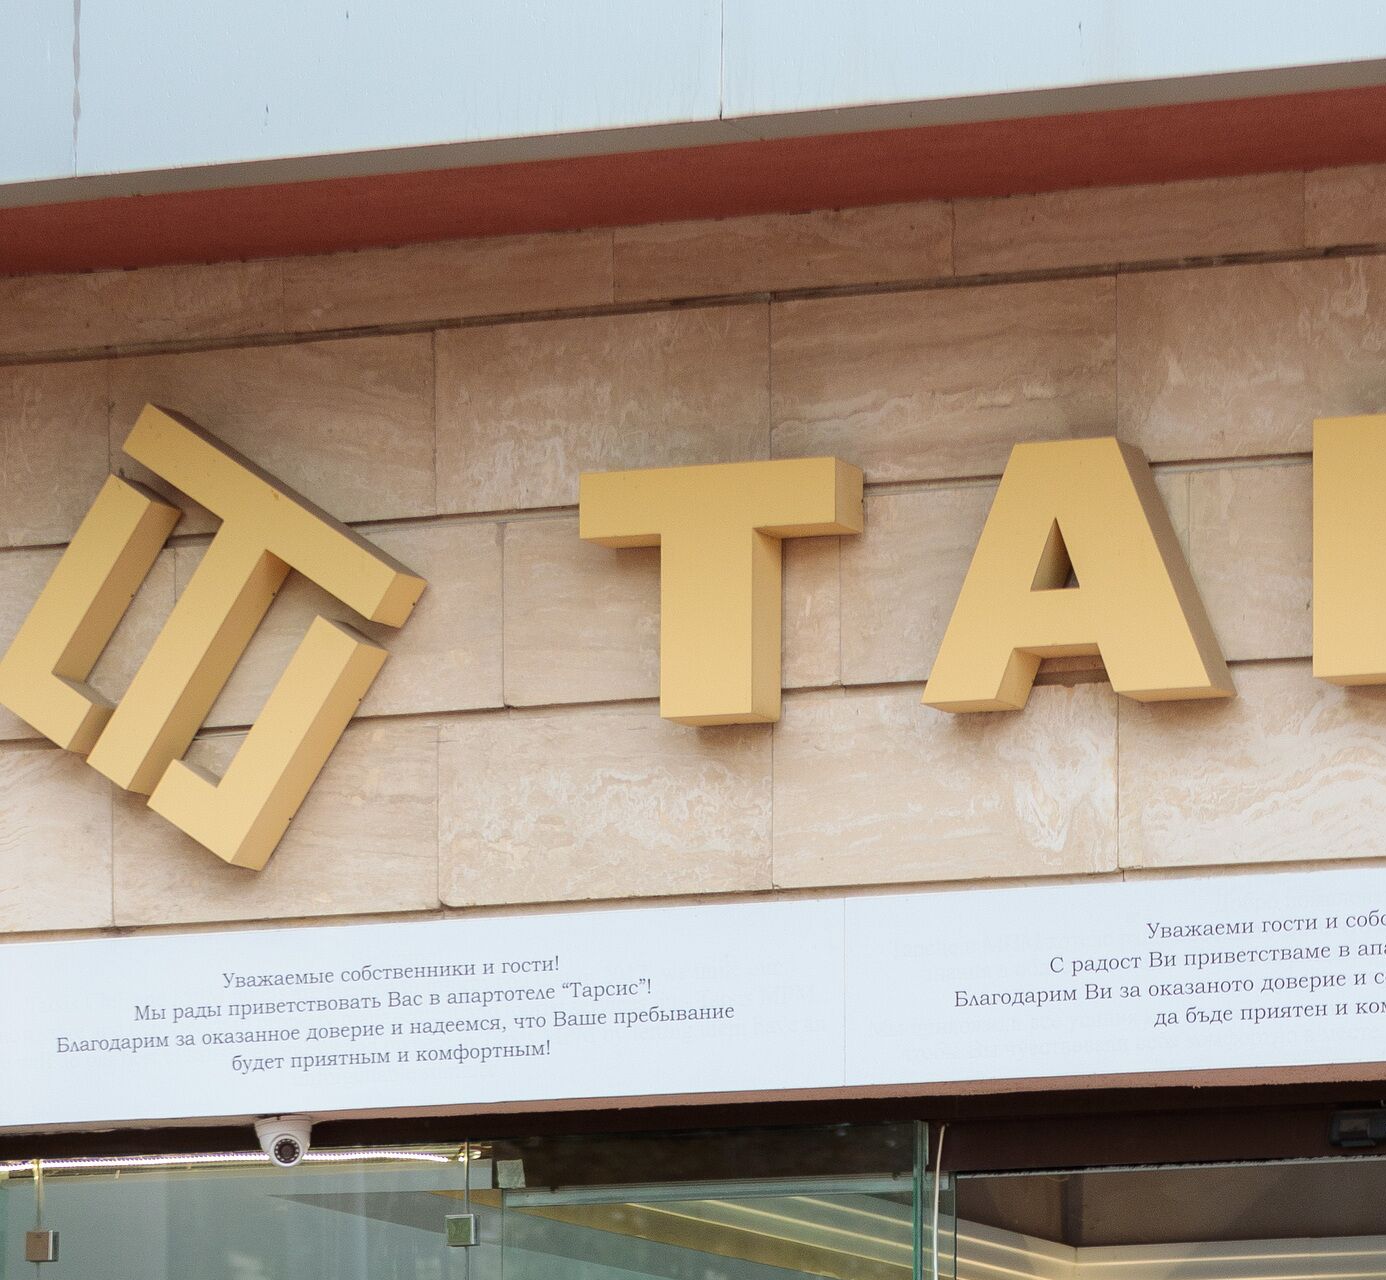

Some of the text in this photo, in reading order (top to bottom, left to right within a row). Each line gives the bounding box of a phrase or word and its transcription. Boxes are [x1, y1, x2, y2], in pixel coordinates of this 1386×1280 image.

[1145, 921, 1255, 940] Уважаеми
[1261, 917, 1318, 934] гости
[1325, 916, 1339, 930] и
[221, 954, 559, 989] Уважаемые собственники и гости!
[1049, 956, 1065, 974] С
[1071, 955, 1143, 978] радост
[1148, 951, 1177, 969] Ви
[1183, 945, 1331, 971] приветстваме
[1338, 944, 1351, 958] в
[133, 1004, 167, 1022] Мы
[172, 1005, 223, 1024] рады
[228, 996, 382, 1021] приветствовать
[387, 991, 423, 1008] Вас
[429, 993, 441, 1006] в
[446, 987, 556, 1008] апартотеле
[954, 988, 1078, 1008] Благодарим
[1084, 983, 1113, 1001] Ви
[1119, 985, 1142, 999] за
[1148, 978, 1255, 997] оказаното
[1259, 974, 1347, 994] доверие
[1352, 972, 1367, 986] и
[55, 1005, 735, 1054] Благодарим за оказанное доверие и надеемся, что Ваше пребывание
[1153, 1012, 1180, 1028] да
[1185, 1005, 1233, 1025] бъде
[1240, 1003, 1328, 1025] приятен
[1335, 1002, 1349, 1016] и
[231, 1054, 286, 1076] будет
[290, 1051, 391, 1073] приятным
[396, 1050, 410, 1063] и
[415, 1039, 551, 1065] комфортным!
